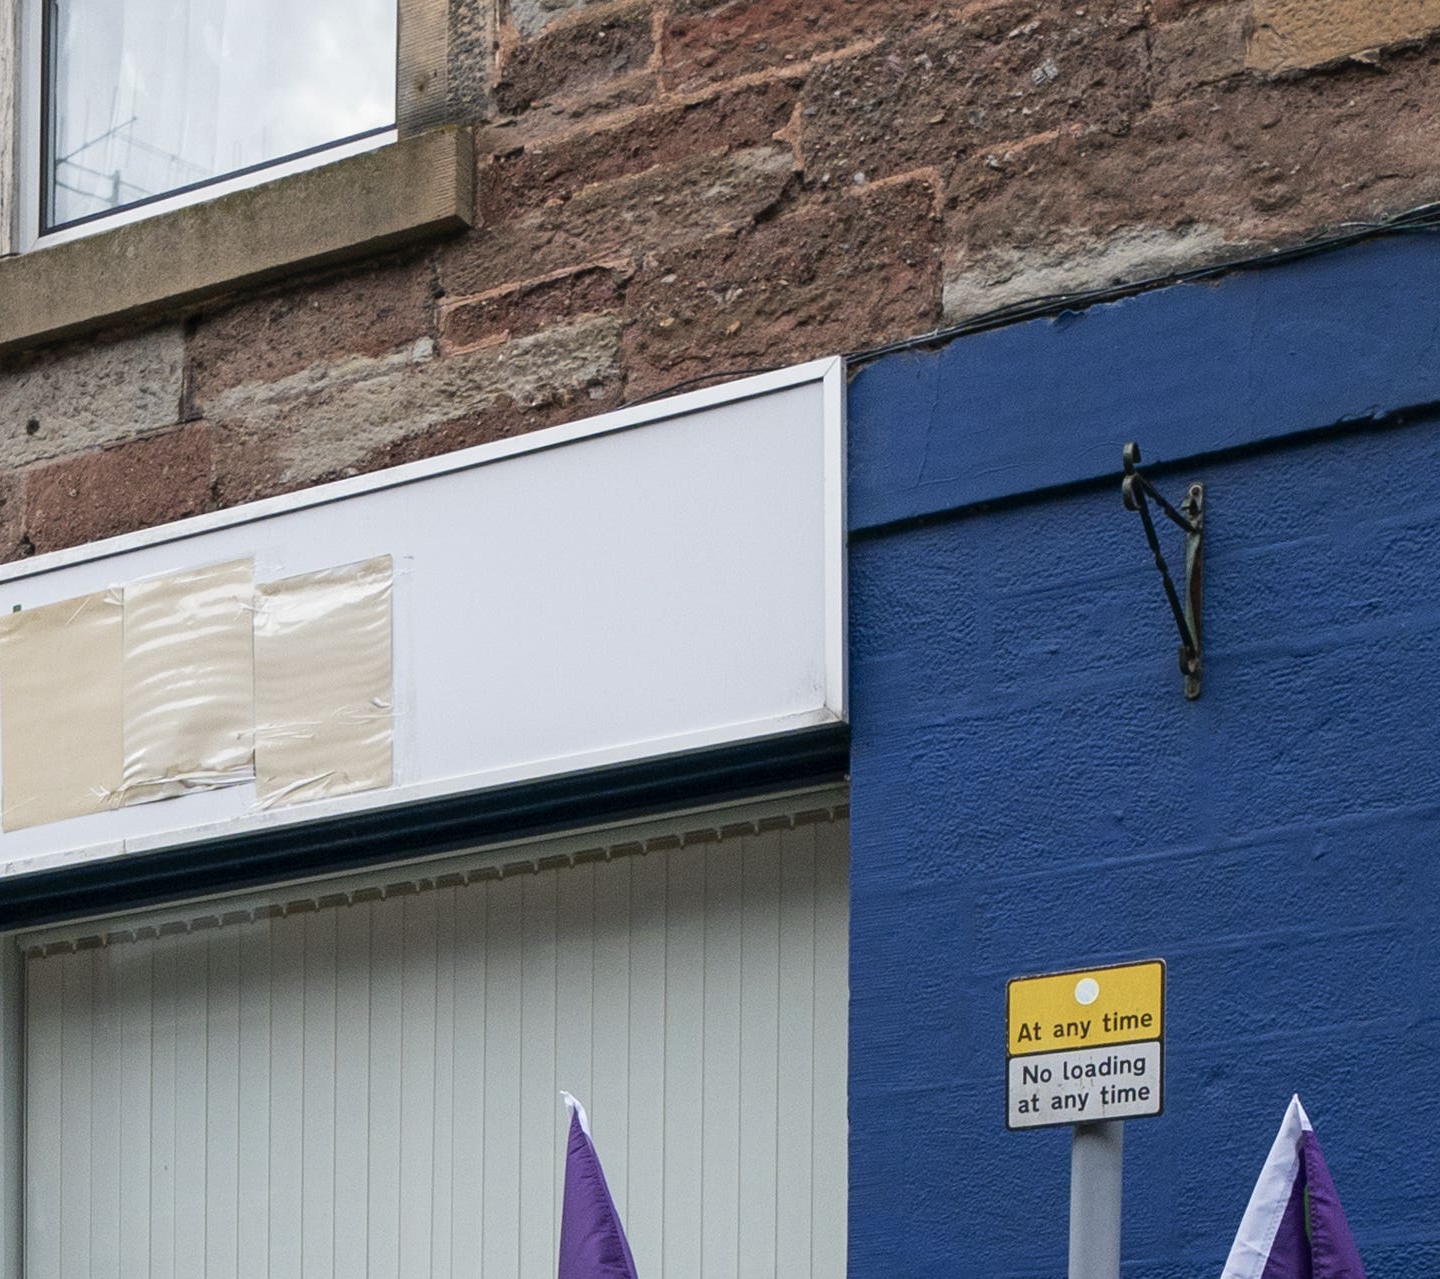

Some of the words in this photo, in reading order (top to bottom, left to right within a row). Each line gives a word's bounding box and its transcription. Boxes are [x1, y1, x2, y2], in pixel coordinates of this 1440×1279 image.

[1017, 1022, 1041, 1042] At
[1053, 1020, 1092, 1040] any
[1102, 1012, 1153, 1033] time
[1022, 1065, 1052, 1085] No
[1063, 1056, 1146, 1081] loading
[1018, 1093, 1040, 1114] at
[1051, 1092, 1090, 1112] any
[1100, 1085, 1150, 1105] time
